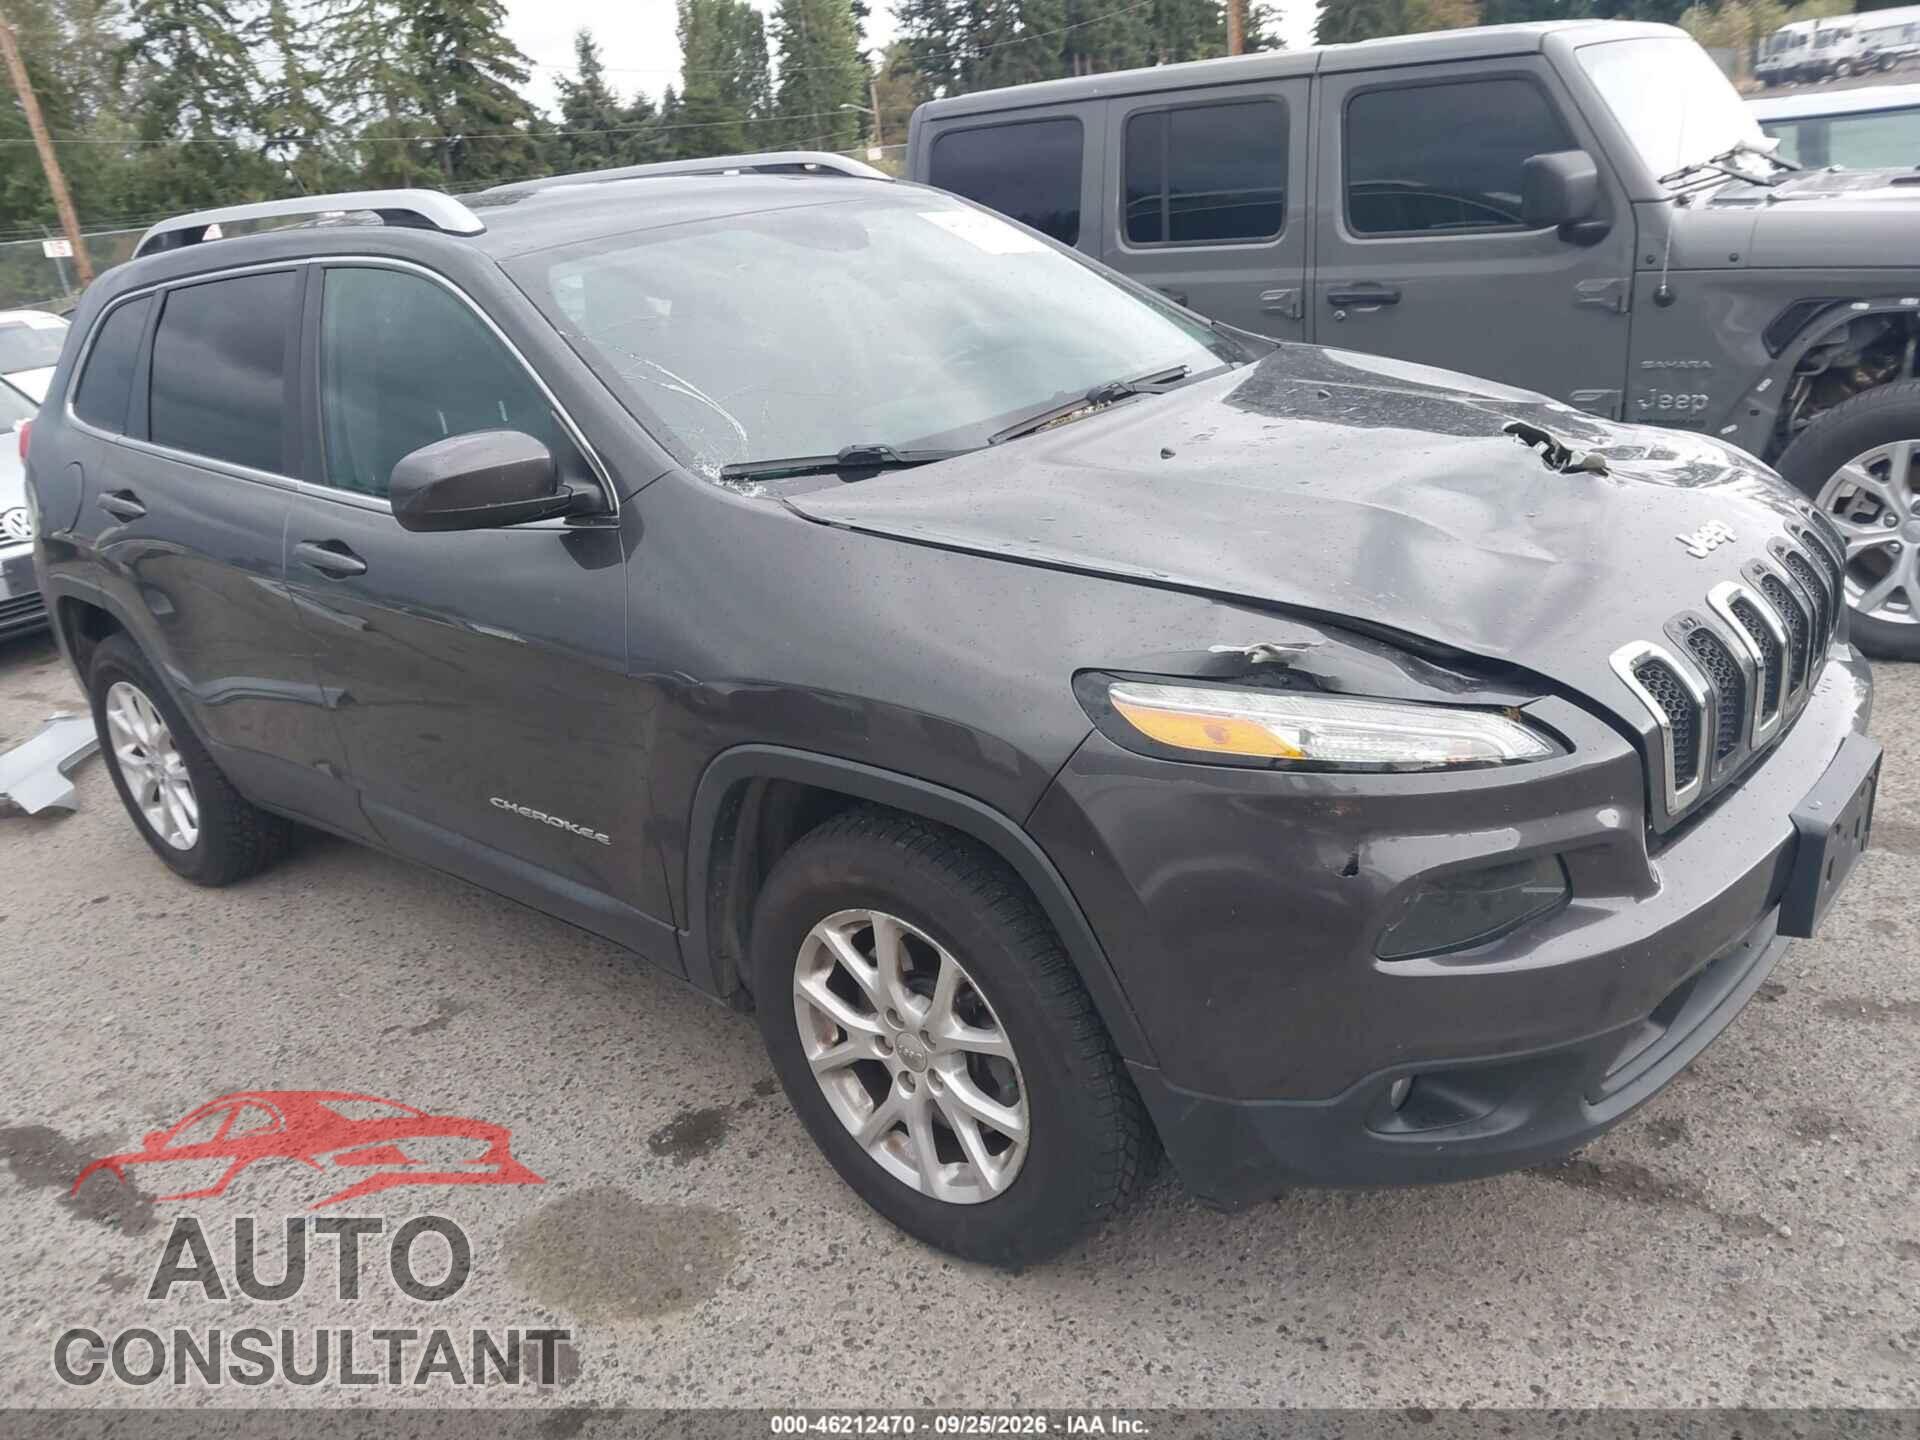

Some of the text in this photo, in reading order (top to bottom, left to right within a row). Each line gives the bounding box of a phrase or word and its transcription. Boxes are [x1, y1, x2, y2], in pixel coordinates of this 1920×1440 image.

[1637, 388, 1709, 415] Jeep
[1675, 520, 1737, 559] Jeep
[489, 797, 611, 846] CHEROKEE
